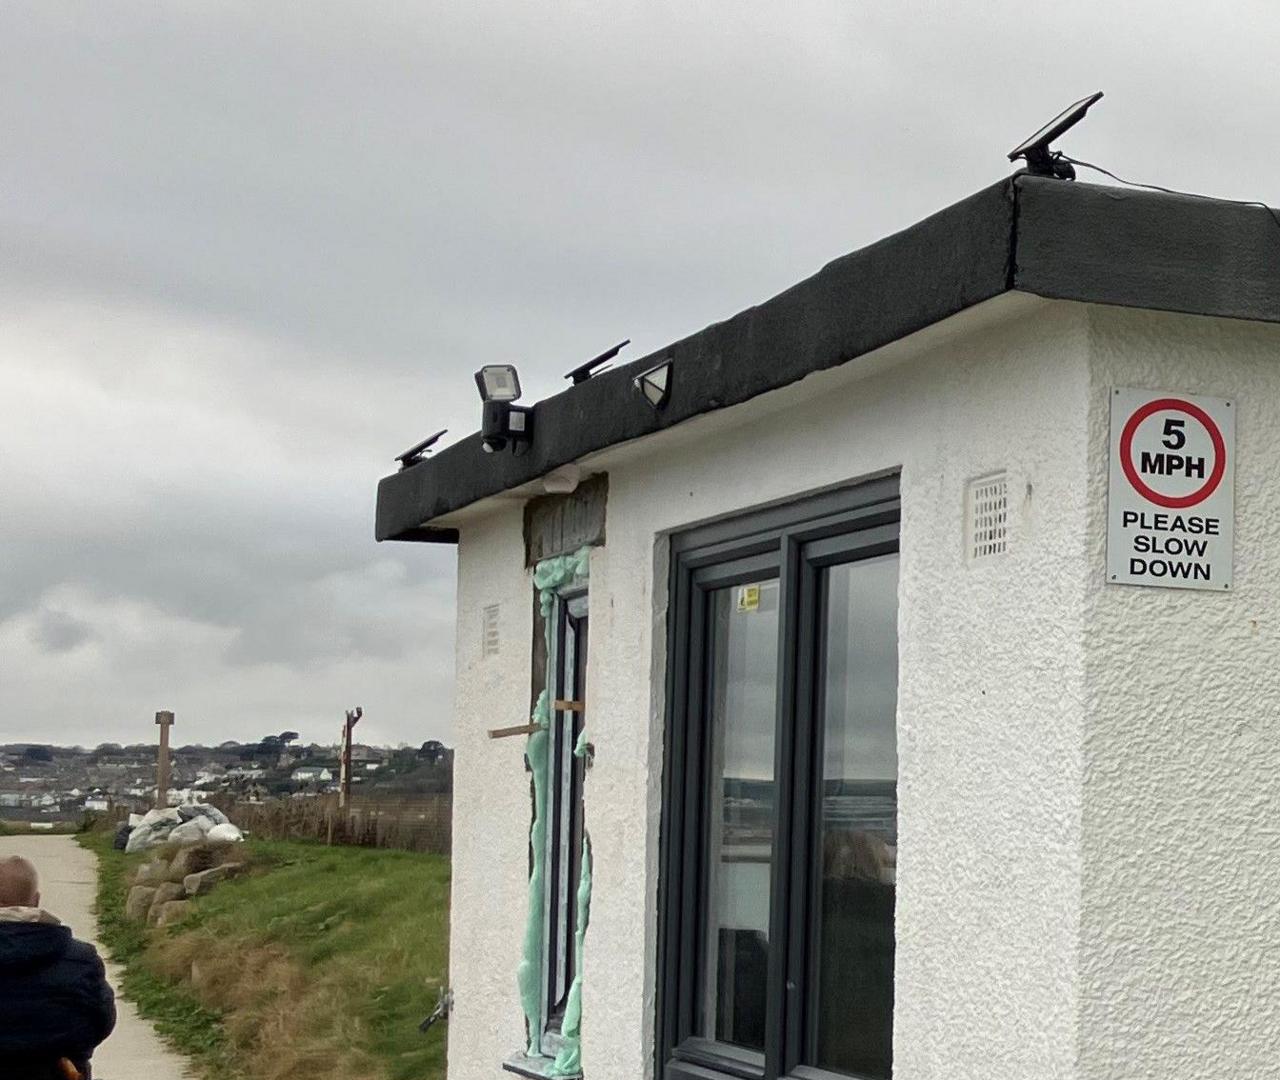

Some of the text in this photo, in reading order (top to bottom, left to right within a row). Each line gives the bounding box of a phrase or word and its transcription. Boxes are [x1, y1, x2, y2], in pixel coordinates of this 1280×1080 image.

[1162, 419, 1186, 450] 5
[1141, 452, 1205, 478] MPH
[1123, 511, 1220, 535] PLEASE
[1133, 536, 1208, 557] SLOW
[1130, 558, 1211, 580] DOWN
